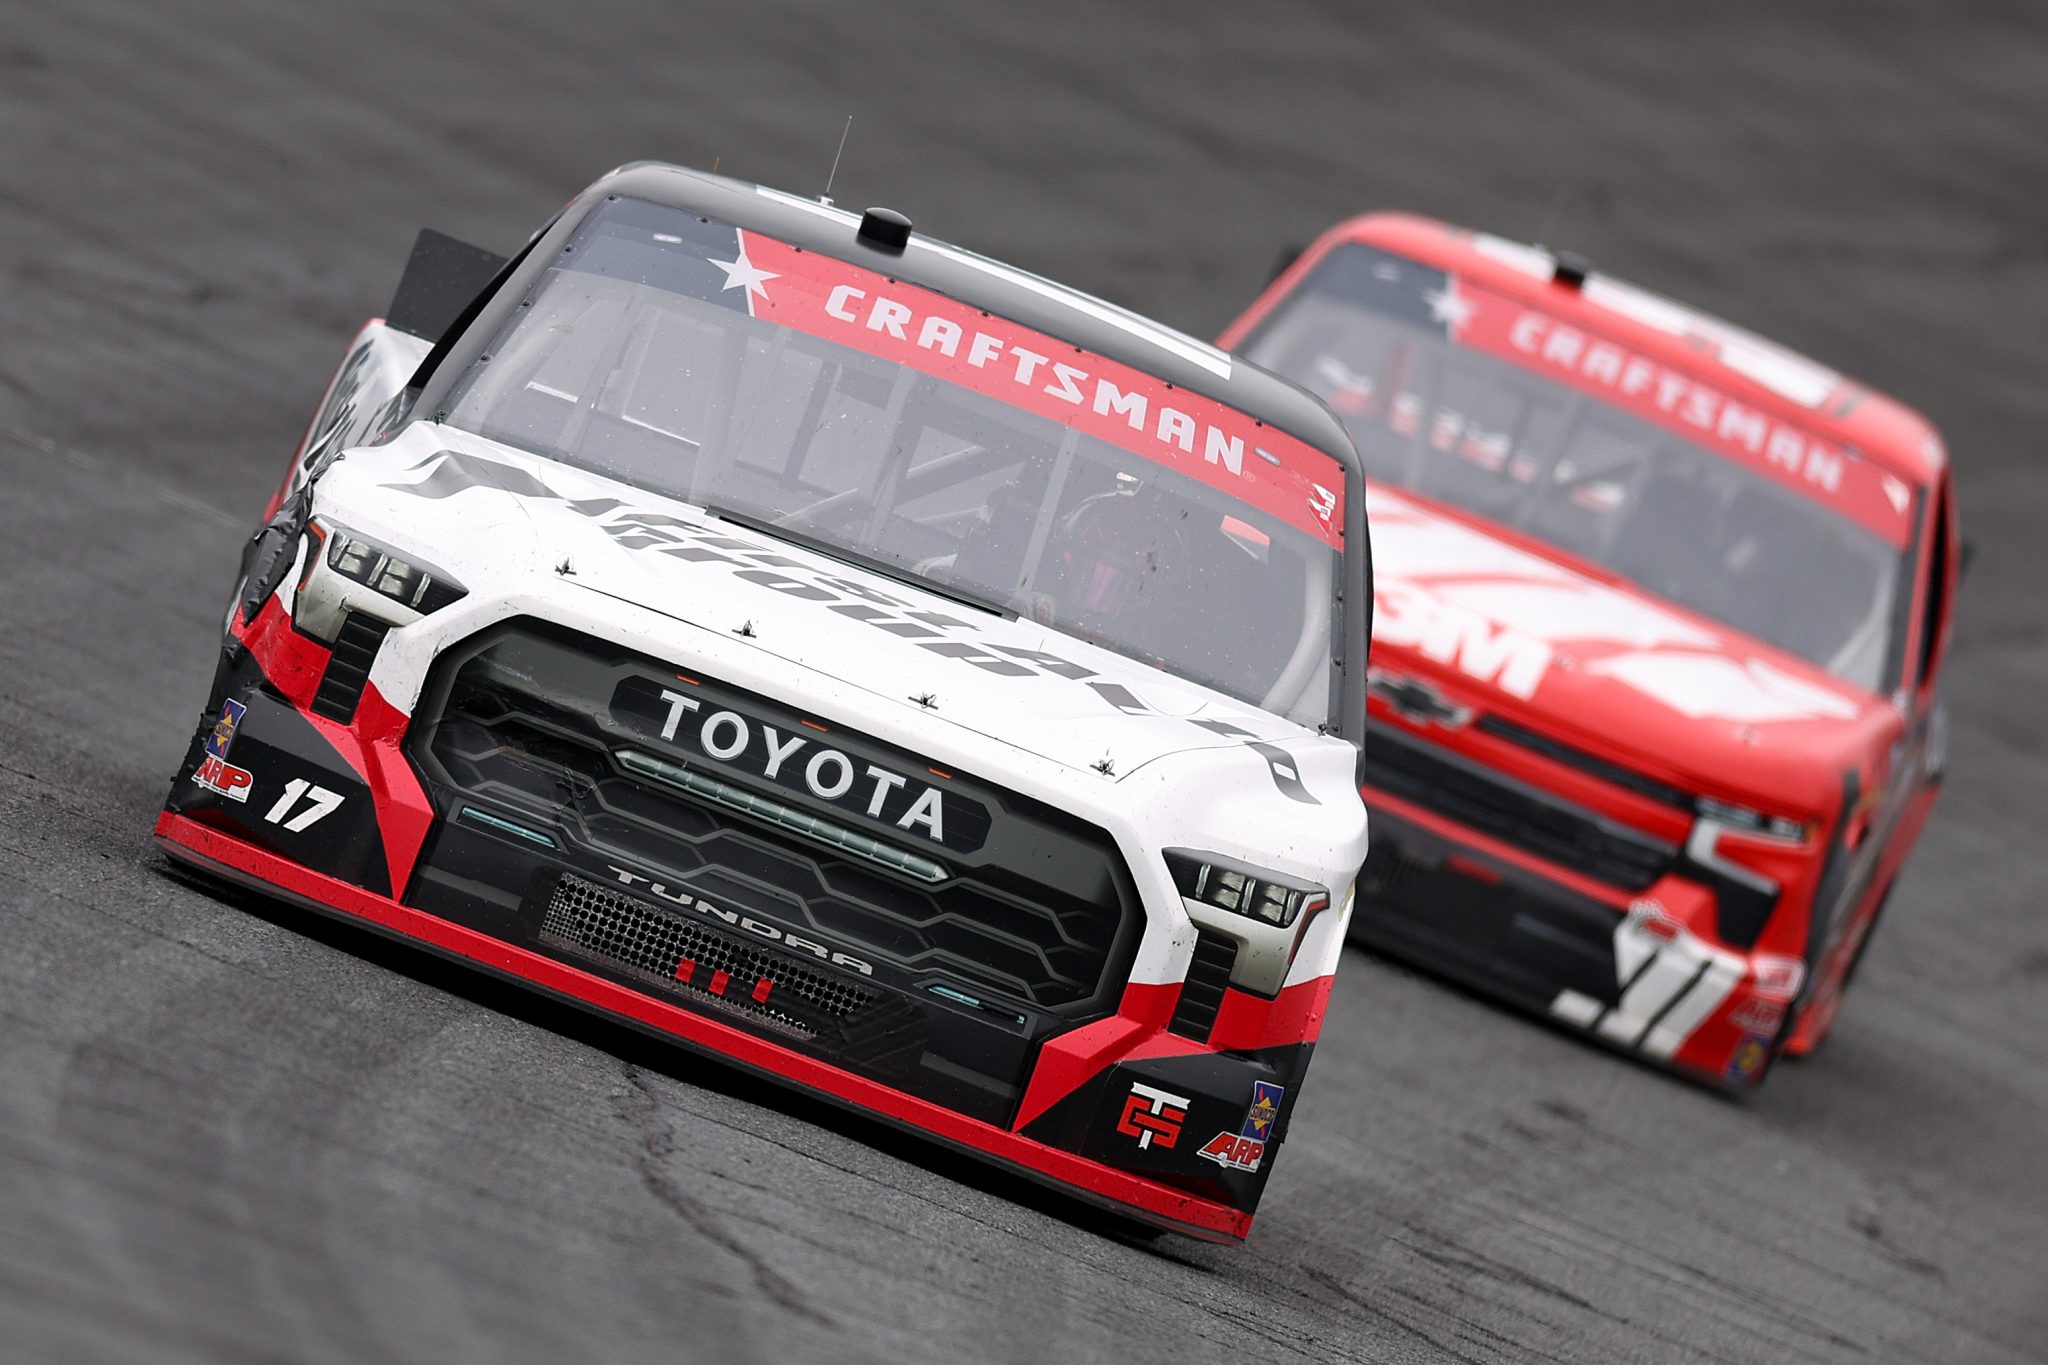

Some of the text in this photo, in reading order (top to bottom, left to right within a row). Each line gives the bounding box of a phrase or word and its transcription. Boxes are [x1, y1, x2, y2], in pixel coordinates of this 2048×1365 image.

[824, 284, 1245, 476] CRAFTSMAN
[1508, 306, 1848, 494] CRAFTSMAN
[1373, 578, 1552, 703] 3M
[264, 777, 346, 833] 17
[657, 688, 944, 844] TOYOTA
[607, 865, 874, 976] TUNDRA
[1201, 1132, 1265, 1166] ARP
